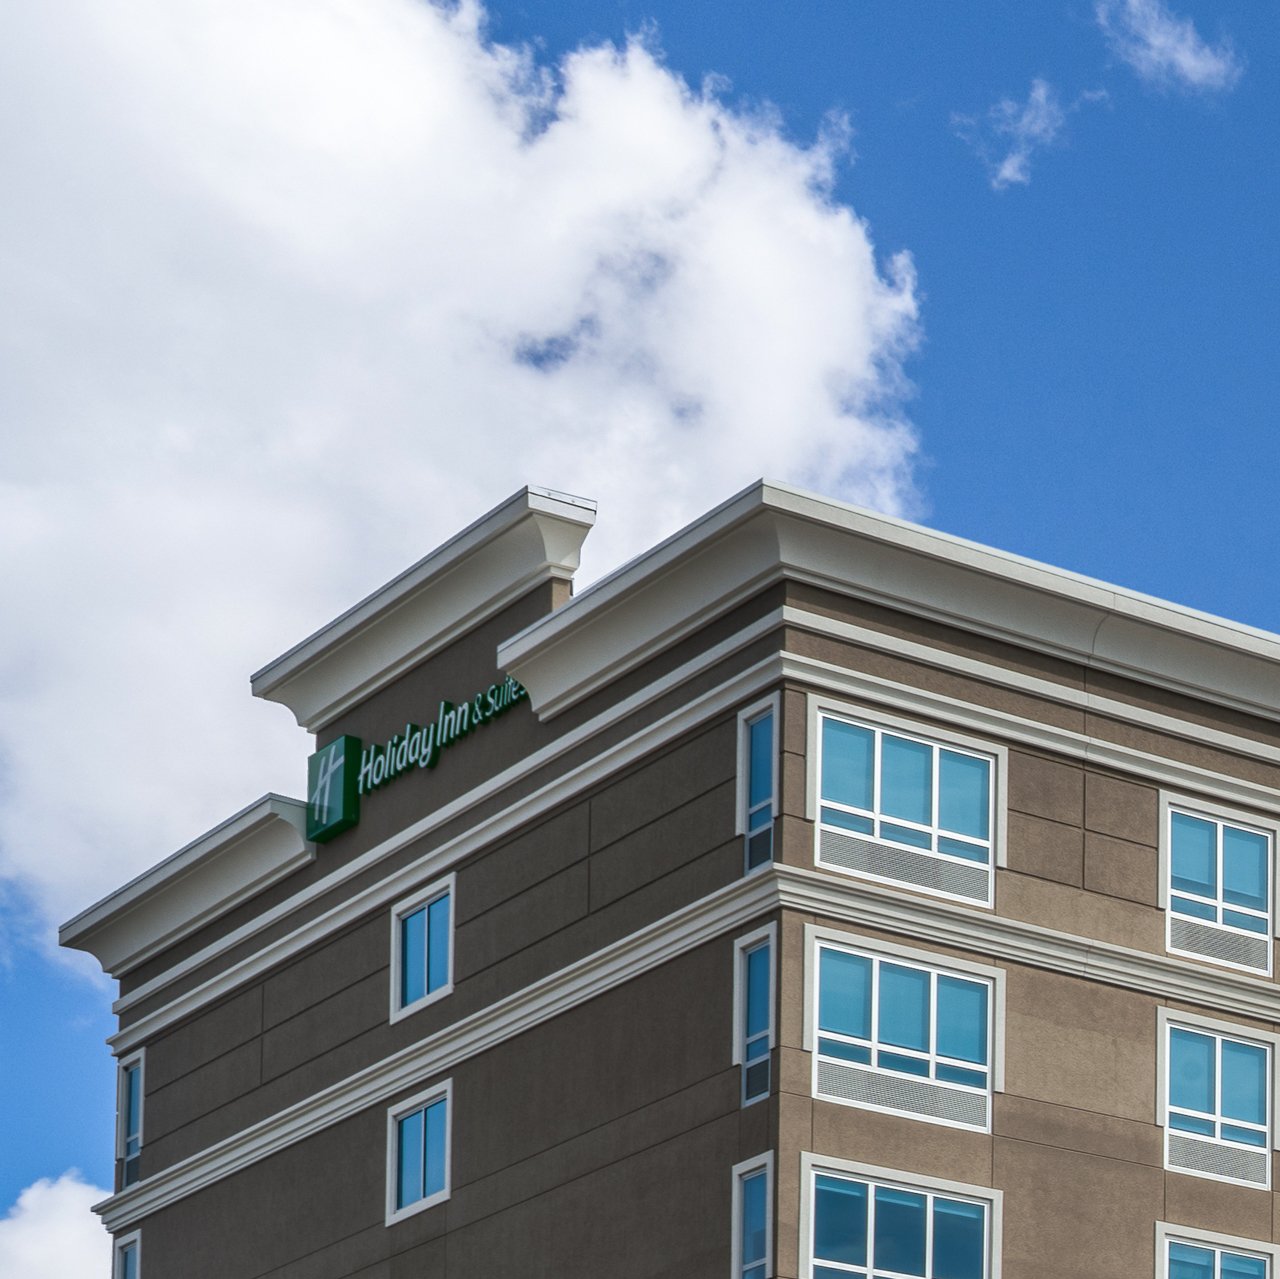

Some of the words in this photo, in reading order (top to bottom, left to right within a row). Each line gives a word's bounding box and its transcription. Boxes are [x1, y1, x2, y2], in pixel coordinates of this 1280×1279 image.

[358, 723, 435, 795] Holiday
[436, 700, 470, 747] Inn
[472, 692, 483, 724] &
